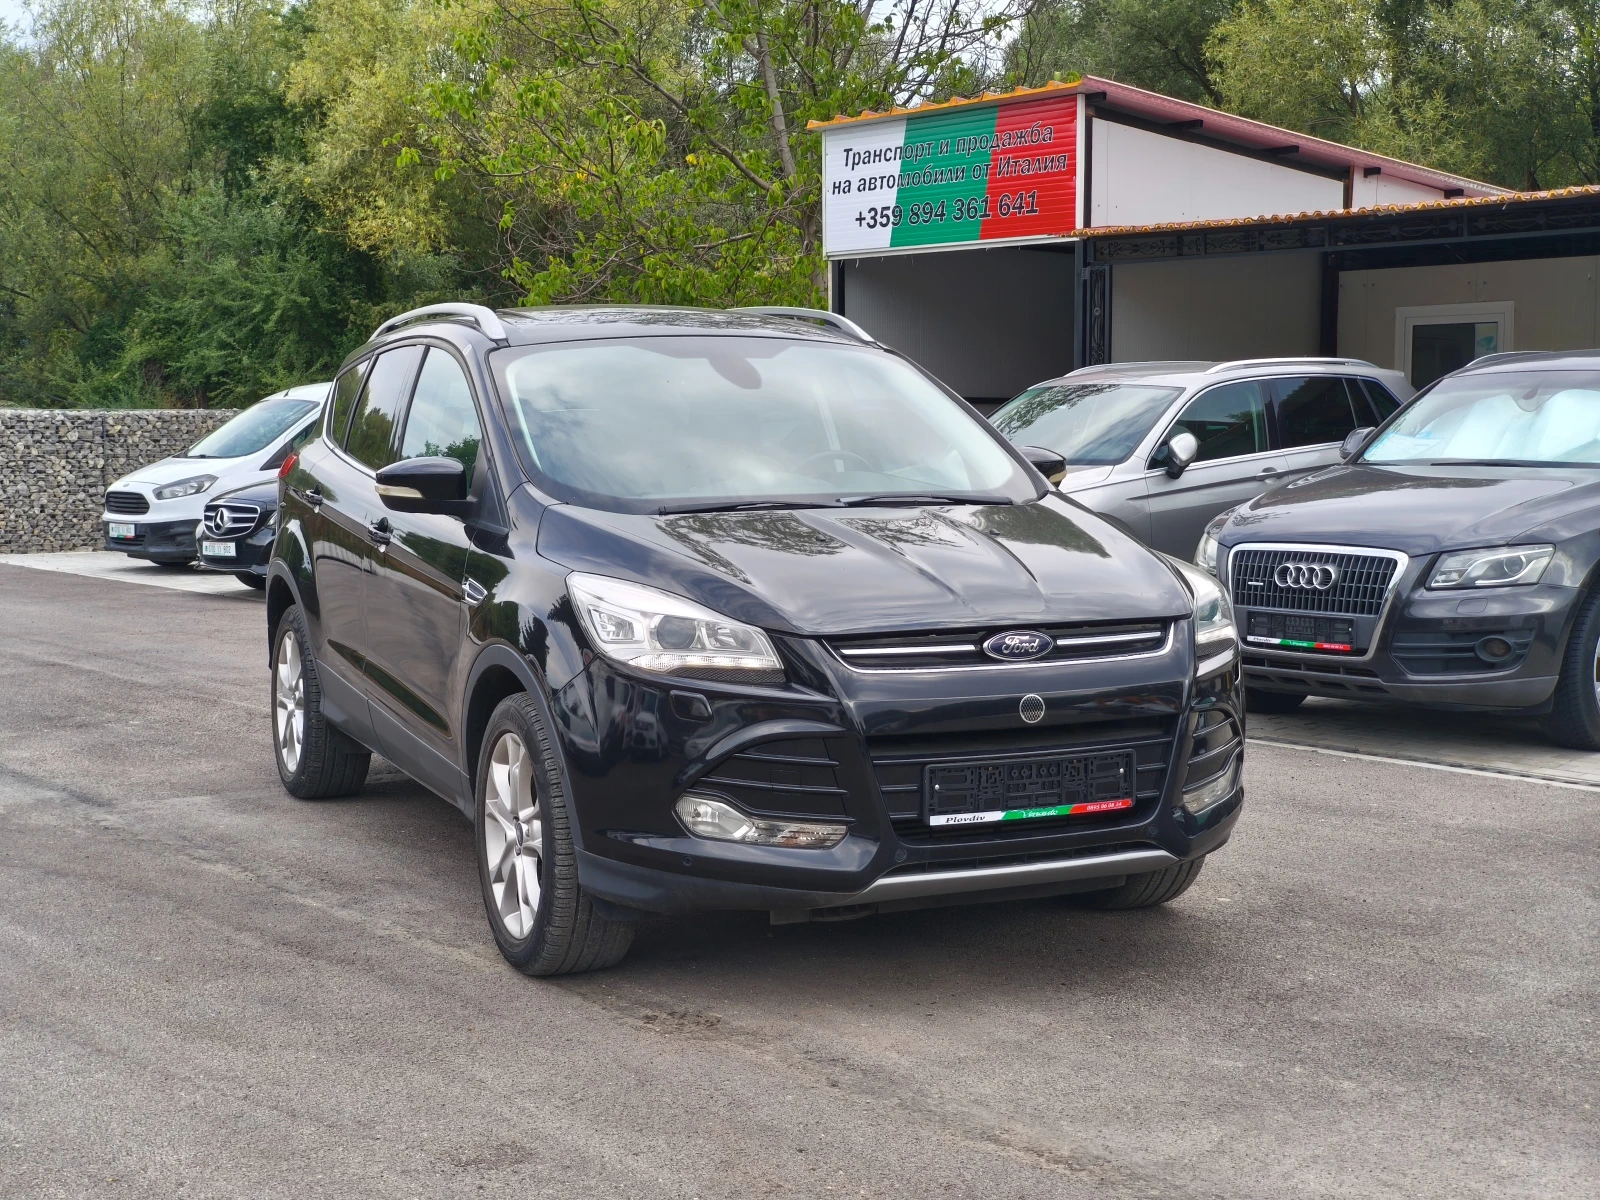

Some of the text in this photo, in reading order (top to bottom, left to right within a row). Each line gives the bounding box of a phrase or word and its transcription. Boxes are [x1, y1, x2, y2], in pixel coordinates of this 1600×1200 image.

[843, 121, 1054, 171] Транспорт и продажба
[831, 153, 1068, 195] на автомобили от Италия
[855, 190, 1039, 229] +359 894 361 641
[1001, 635, 1040, 654] Ford
[945, 814, 986, 824] Plovdiv
